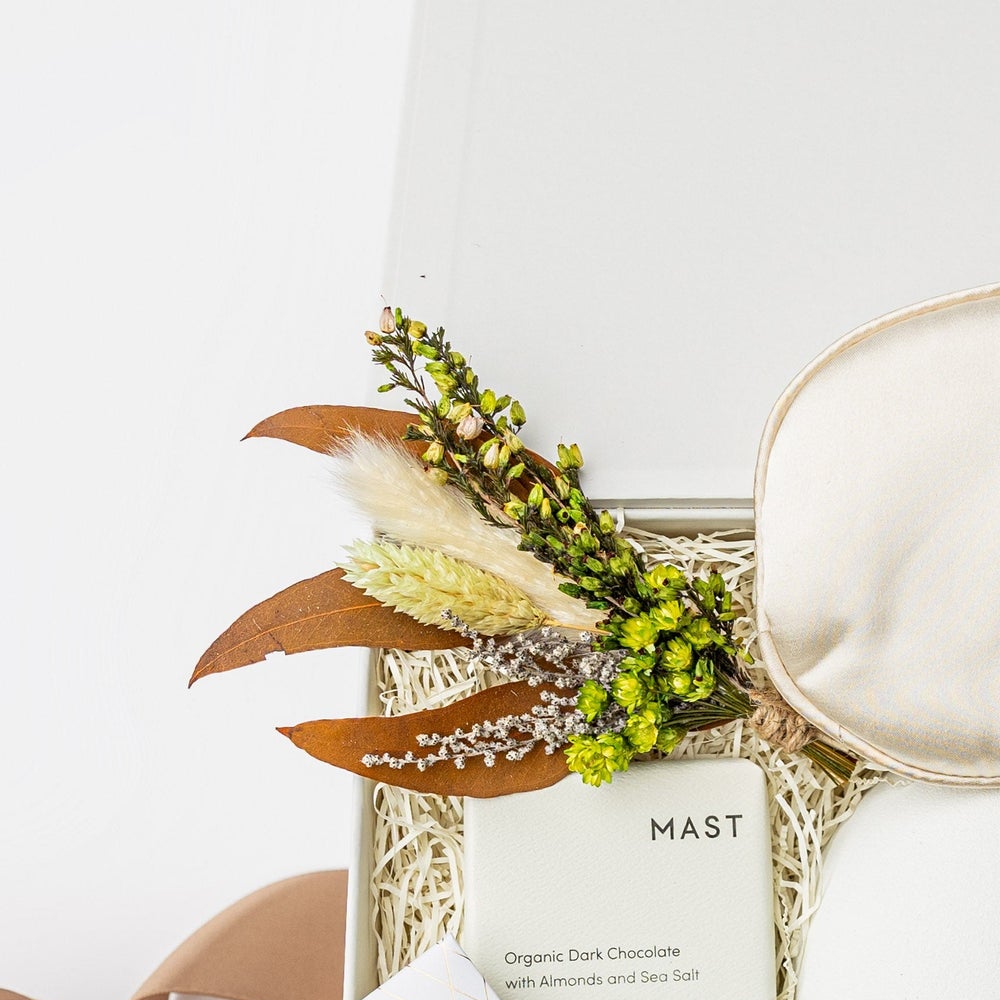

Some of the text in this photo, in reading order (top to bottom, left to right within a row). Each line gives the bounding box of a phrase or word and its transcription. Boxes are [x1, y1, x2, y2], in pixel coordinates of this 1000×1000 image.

[650, 814, 743, 841] MAST
[504, 945, 681, 968] Organic Dark Chocolate
[504, 968, 700, 990] with Almonds and Sea Salt
